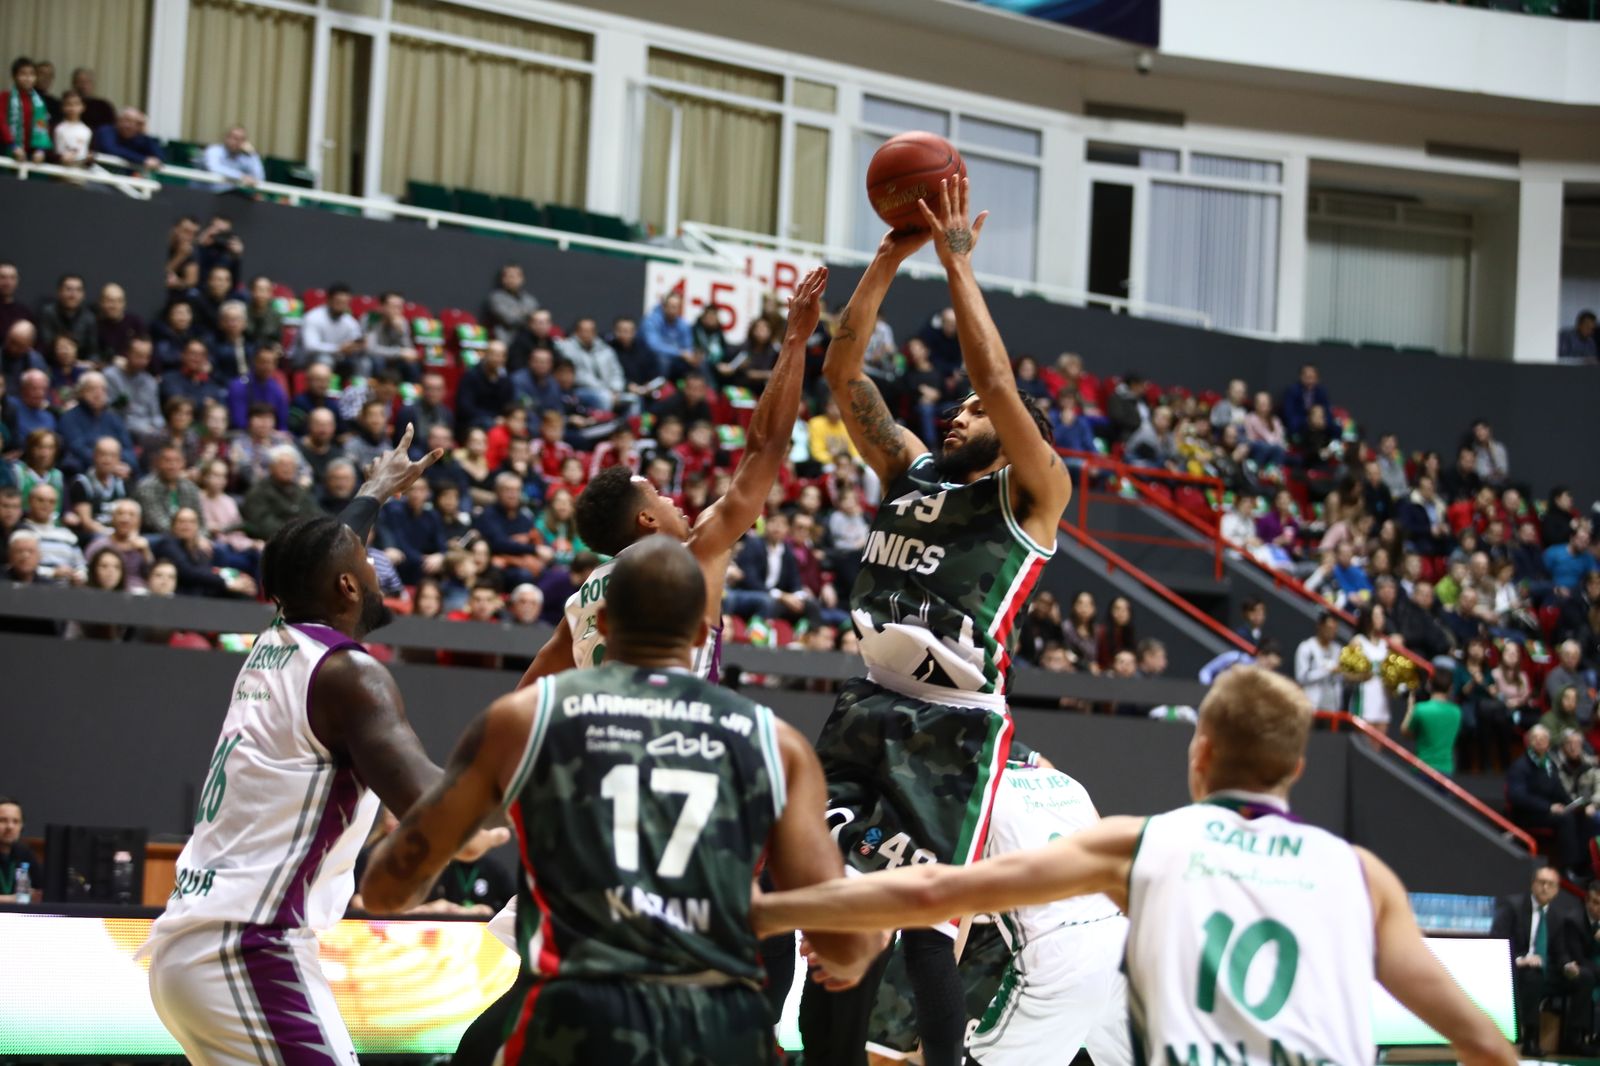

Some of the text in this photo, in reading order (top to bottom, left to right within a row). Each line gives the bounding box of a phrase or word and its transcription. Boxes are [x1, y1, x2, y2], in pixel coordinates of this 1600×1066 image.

[563, 693, 754, 737] CARMICHAEL JR
[600, 764, 720, 878] 17
[1205, 820, 1303, 857] SALIN
[1196, 910, 1300, 1021] 10
